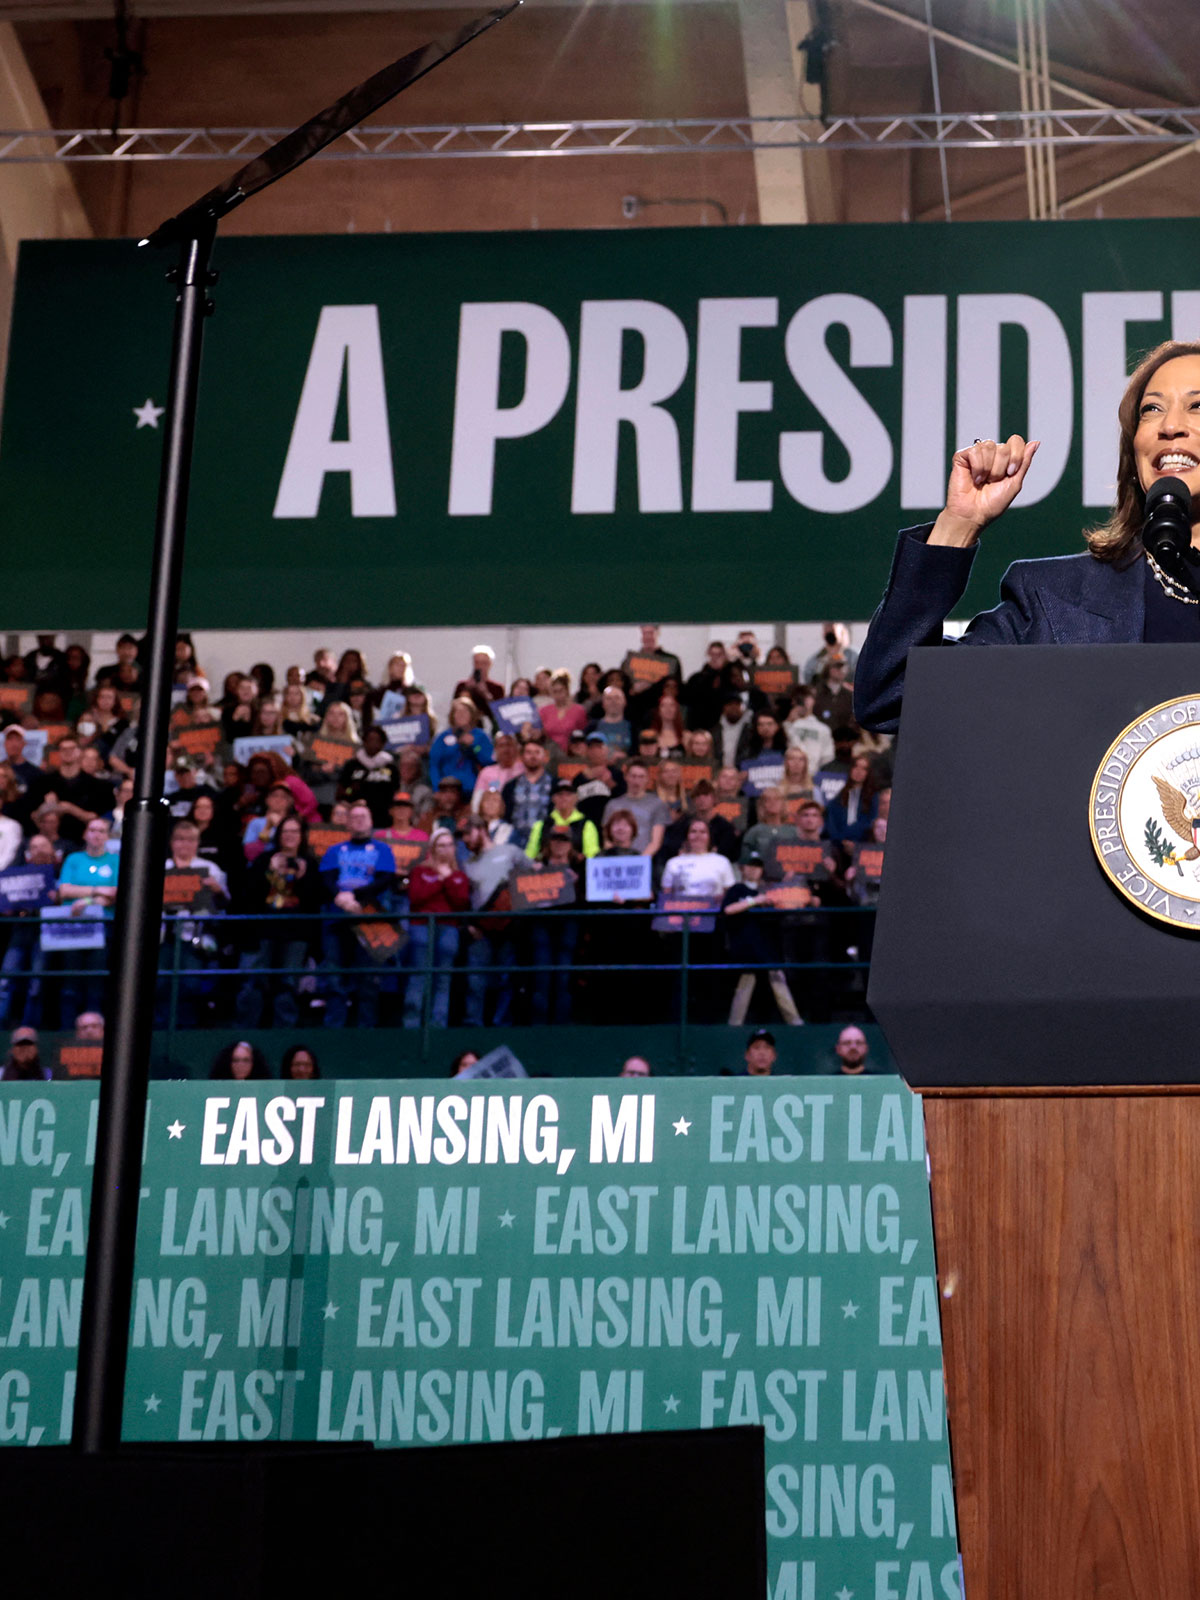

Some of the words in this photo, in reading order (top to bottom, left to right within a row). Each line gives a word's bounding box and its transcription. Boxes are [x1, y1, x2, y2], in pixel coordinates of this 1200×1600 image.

[274, 305, 396, 518] A
[1171, 704, 1197, 724] OF
[1096, 718, 1163, 857] PRESIDENT
[1116, 862, 1172, 916] VICE
[201, 1096, 325, 1165] EAST
[335, 1095, 576, 1174] LANSING,
[590, 1095, 655, 1163] MI
[710, 1094, 833, 1162] EAST
[160, 1186, 399, 1266] LANSING,
[415, 1187, 480, 1254] MI
[534, 1185, 658, 1254] EAST
[672, 1184, 918, 1264] LANSING,
[238, 1278, 304, 1347] MI
[357, 1277, 482, 1347] EAST
[495, 1277, 740, 1358] LANSING,
[757, 1277, 821, 1346] MI
[178, 1370, 304, 1440] EAST
[578, 1370, 644, 1434] MI
[700, 1369, 827, 1442] EAST
